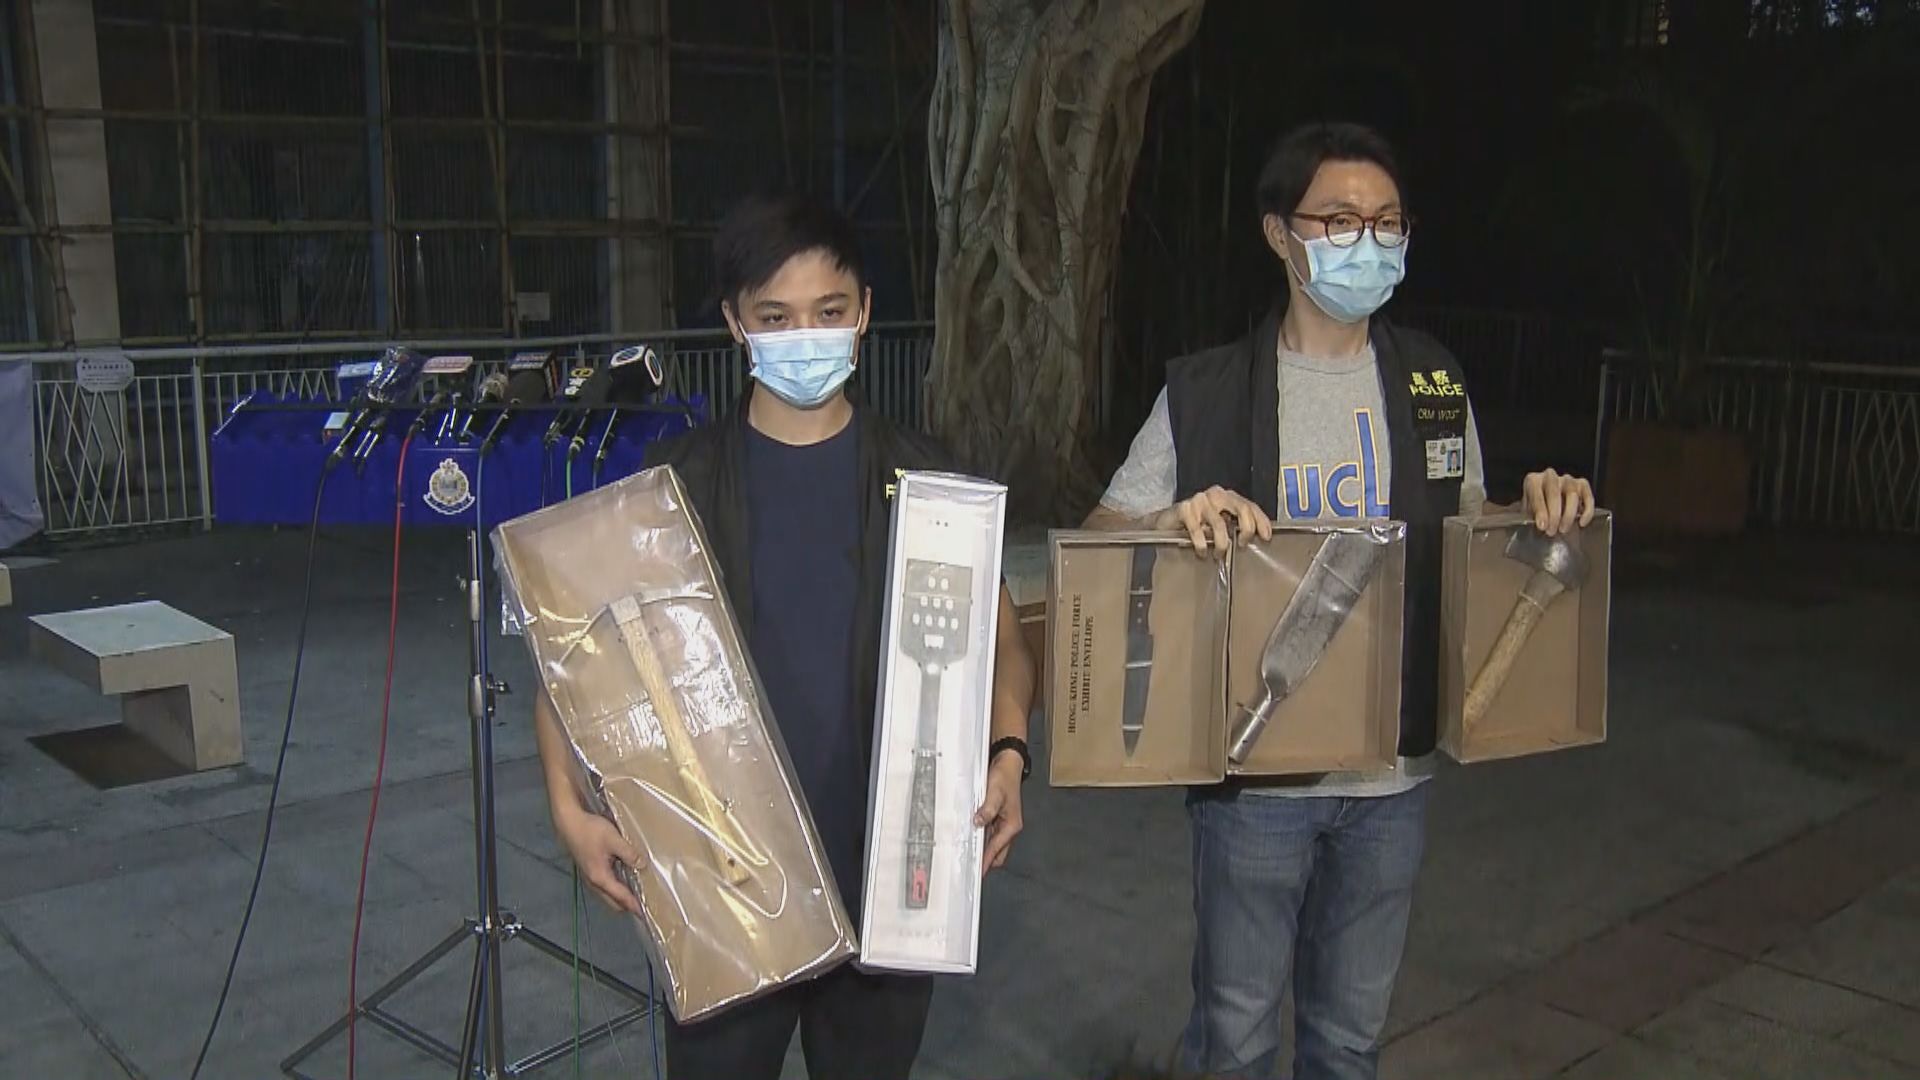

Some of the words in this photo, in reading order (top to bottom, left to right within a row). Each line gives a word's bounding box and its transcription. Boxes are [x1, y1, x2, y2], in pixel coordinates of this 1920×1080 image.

[1409, 383, 1464, 397] POLICE
[1072, 593, 1082, 627] FORCE
[1070, 630, 1080, 668] POLICE
[1083, 616, 1094, 667] ENVELOPE
[1069, 672, 1078, 702] KONG
[1081, 673, 1091, 712] EXHIBIT
[1067, 703, 1077, 734] HONG
